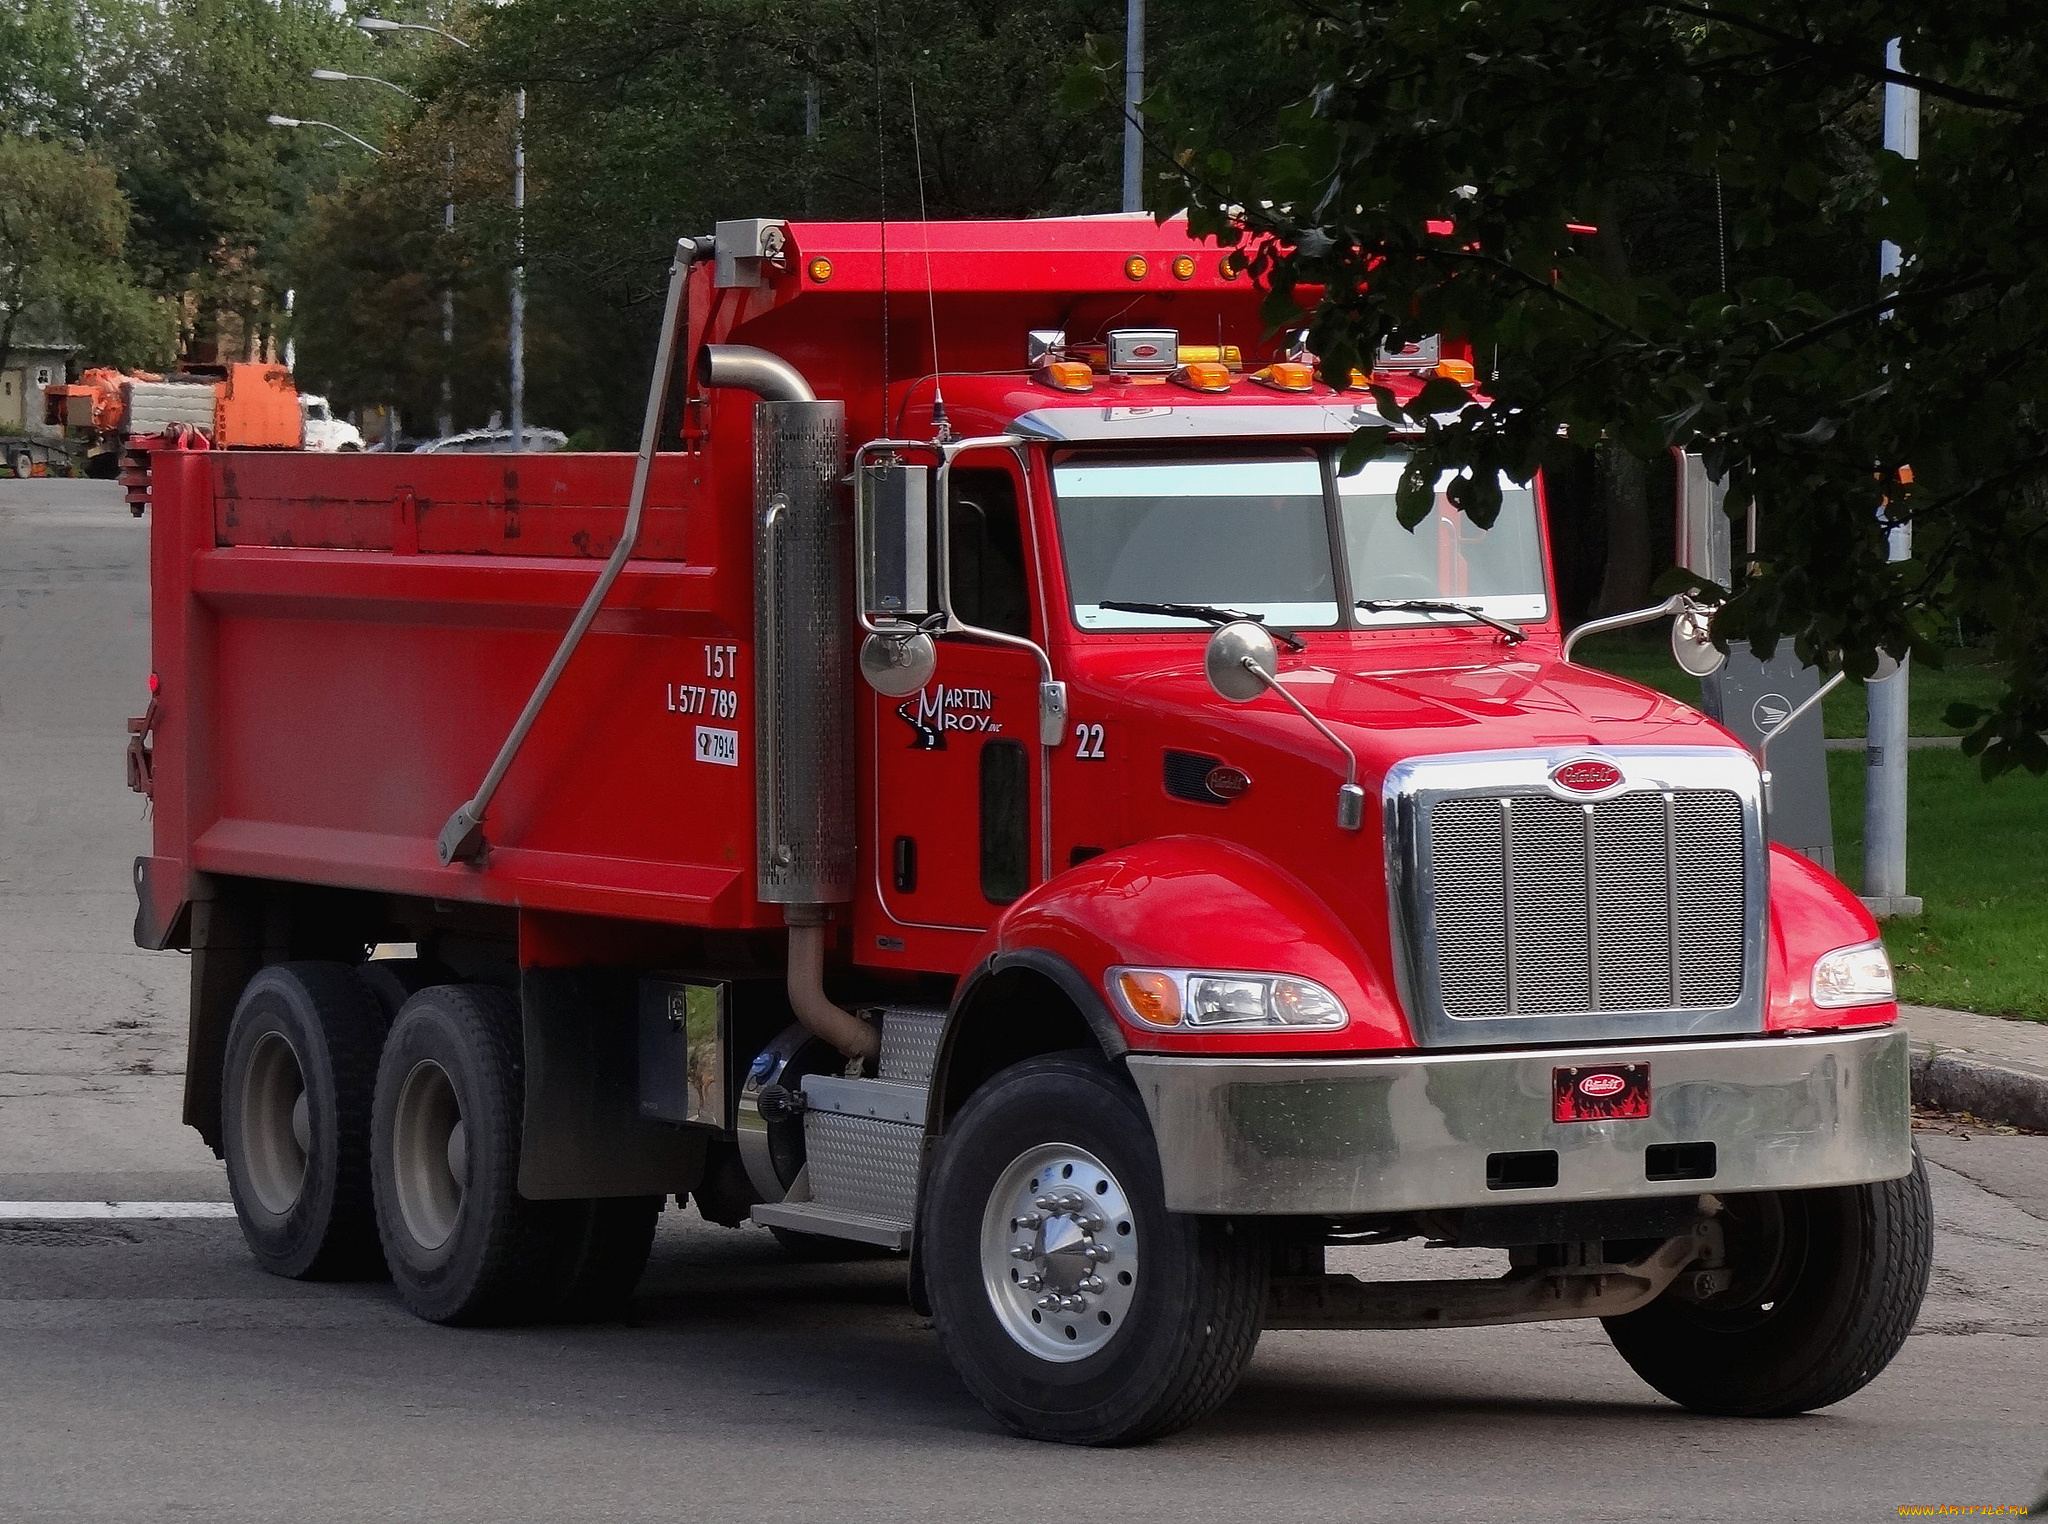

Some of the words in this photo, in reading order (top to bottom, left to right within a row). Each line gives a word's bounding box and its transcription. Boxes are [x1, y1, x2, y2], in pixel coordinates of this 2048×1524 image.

[704, 645, 737, 678] 15T
[667, 683, 676, 711] L
[680, 685, 706, 713] 577
[710, 688, 738, 718] 789
[917, 684, 991, 731] MARTIN
[944, 714, 991, 732] ROY
[713, 735, 735, 759] 7914
[1076, 723, 1105, 758] 22
